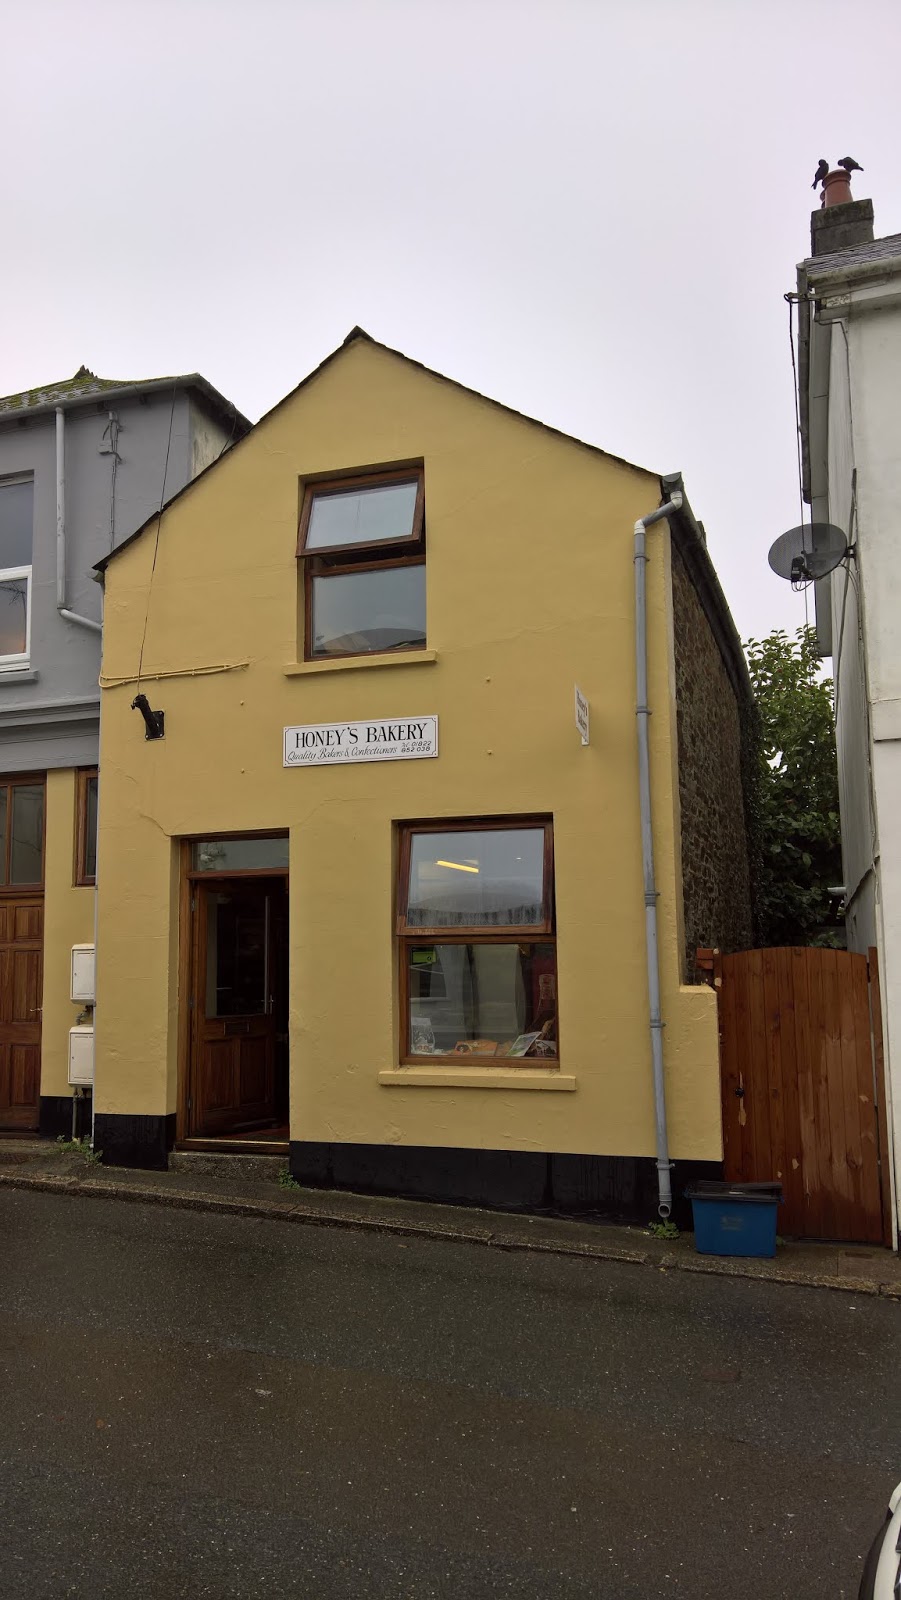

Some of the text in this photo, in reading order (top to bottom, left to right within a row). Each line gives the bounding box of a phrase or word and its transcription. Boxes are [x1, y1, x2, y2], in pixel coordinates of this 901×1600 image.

[295, 723, 428, 749] HONEY'S BAKERY
[287, 750, 316, 762] Quality
[317, 747, 343, 760] Bakers
[351, 745, 398, 757] Confectioners
